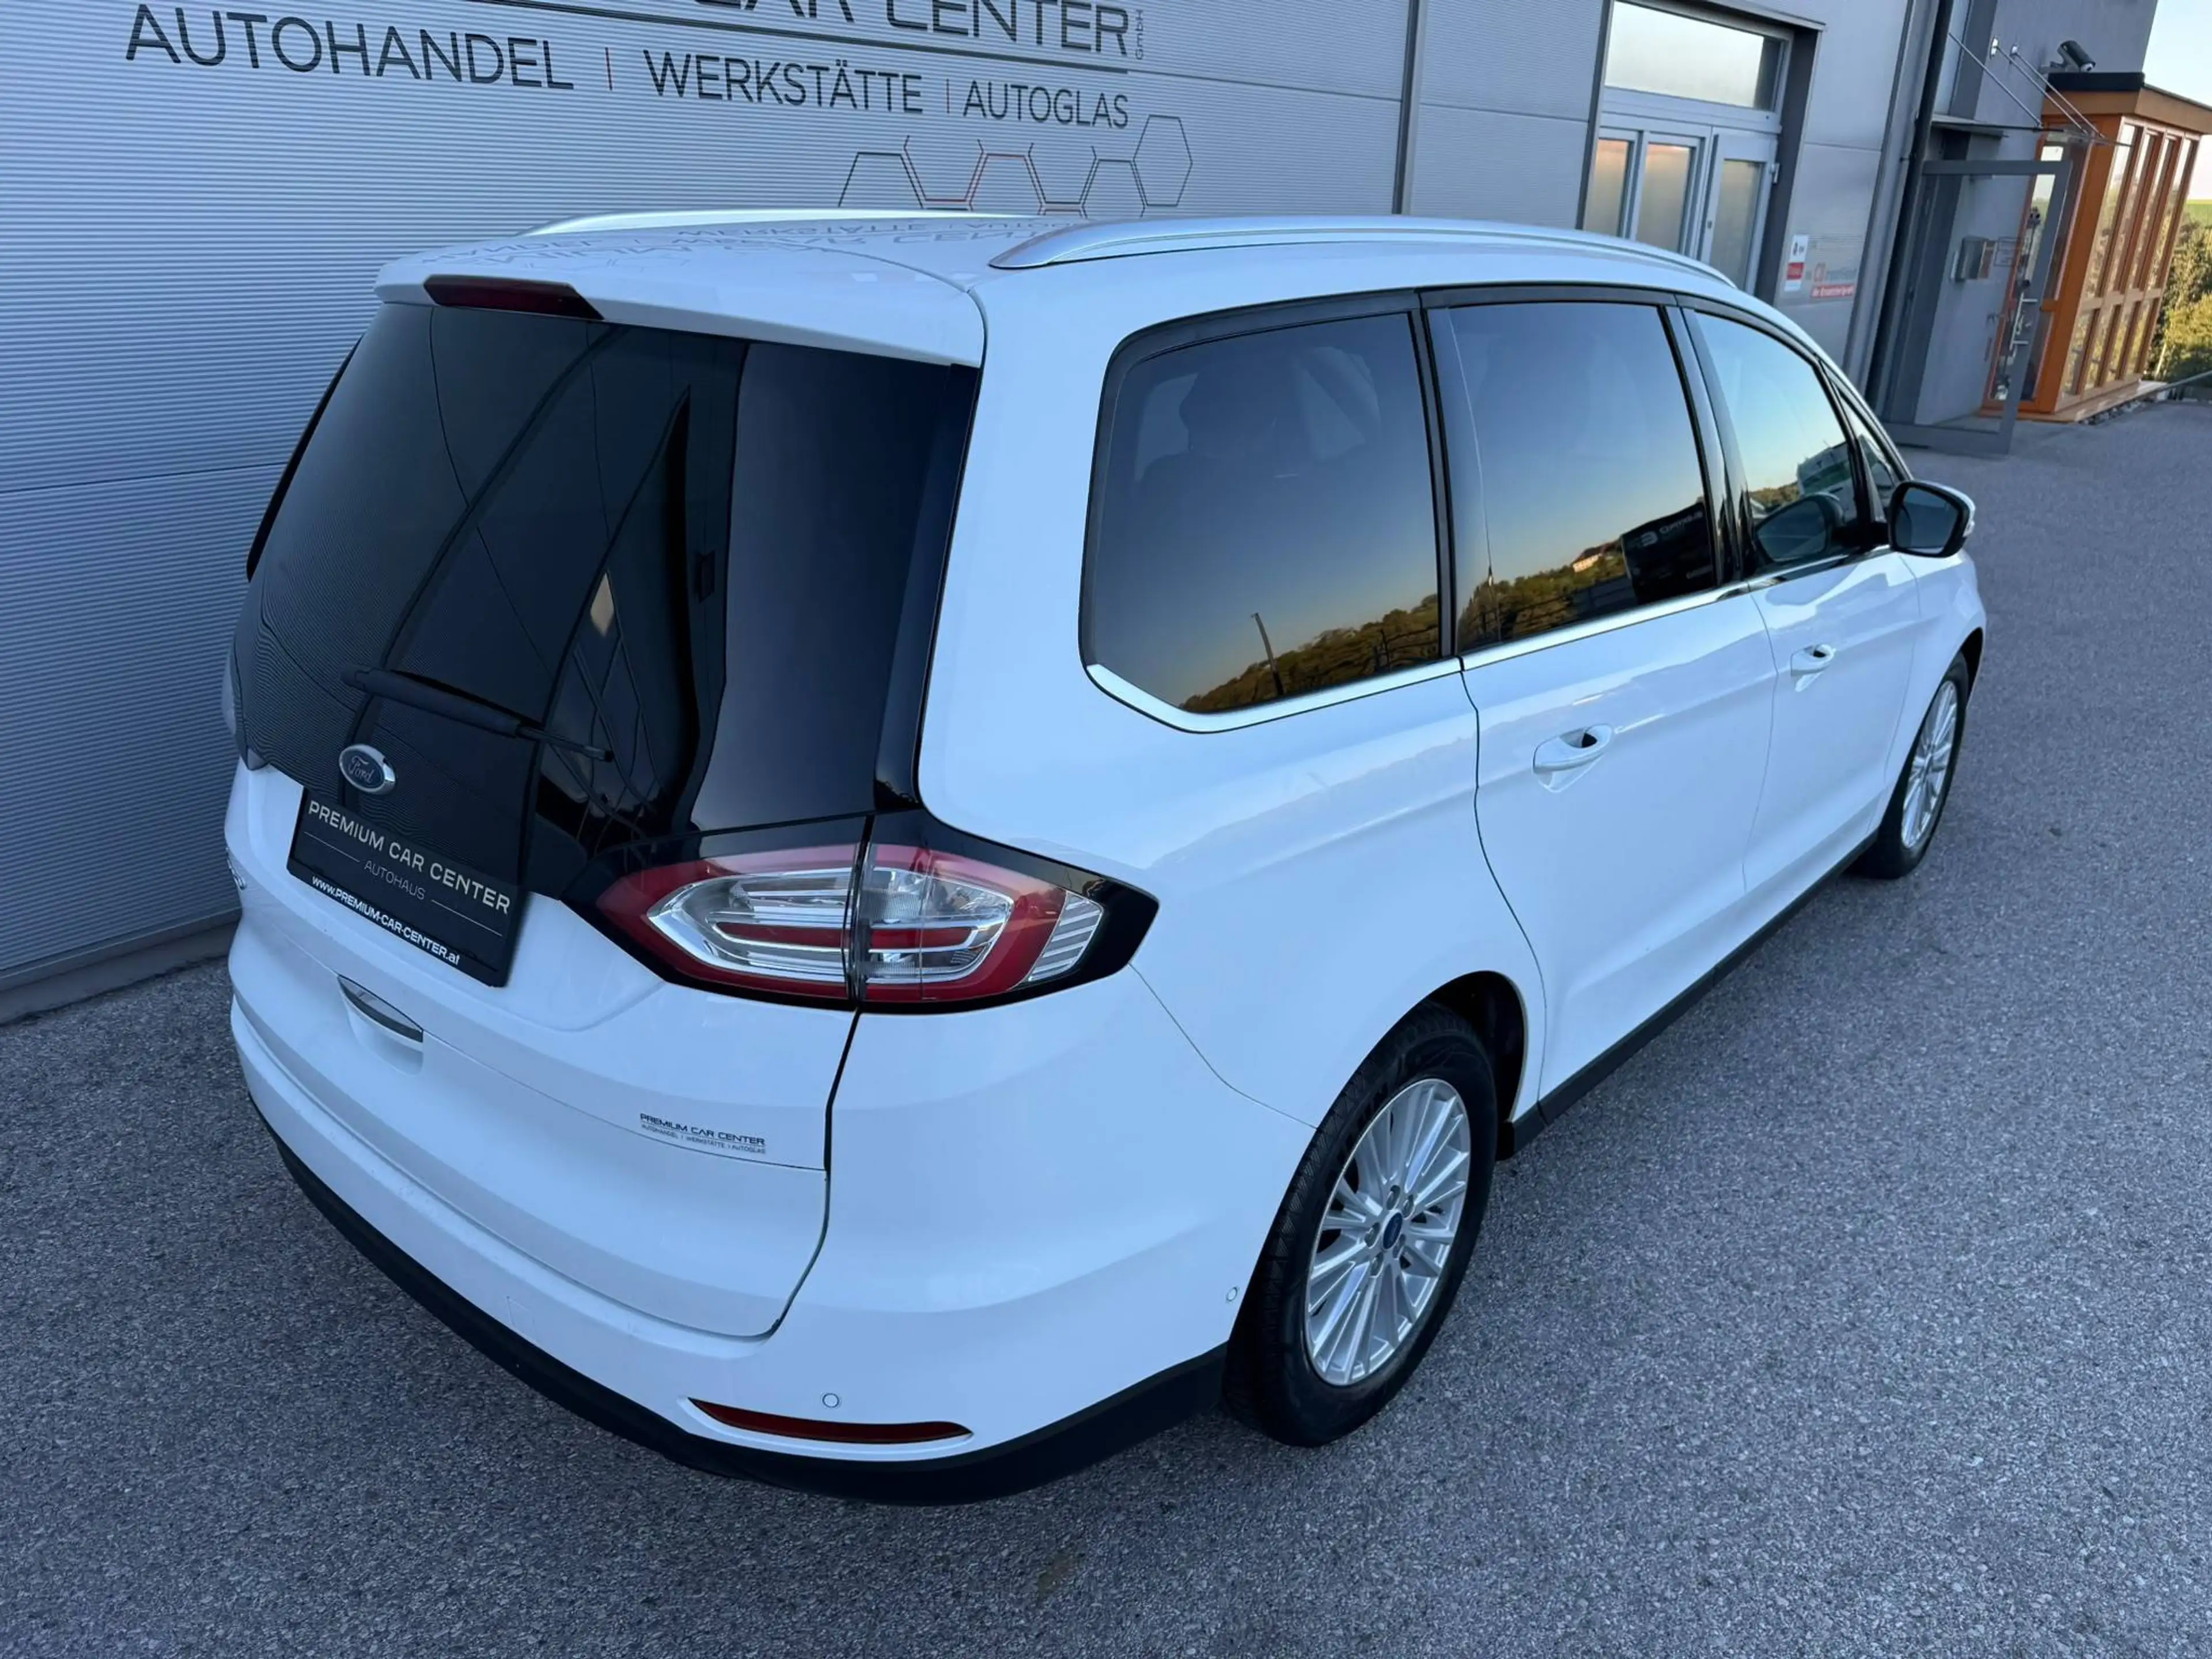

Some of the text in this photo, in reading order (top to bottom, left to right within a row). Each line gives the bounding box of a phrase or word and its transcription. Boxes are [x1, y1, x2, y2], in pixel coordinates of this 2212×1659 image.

[885, 0, 1128, 56] CENTER
[126, 3, 1128, 128] AUTOHANDEL WERKSTÄTTE AUTOGLAS
[348, 755, 374, 785] Ford
[308, 800, 511, 915] PREMIUM CAR CENTER
[364, 859, 426, 900] AUTOHAUS
[312, 876, 460, 965] www.PREMIUM-CAR-CENTER.at
[640, 1113, 766, 1146] PREMIUM CAR CENTER
